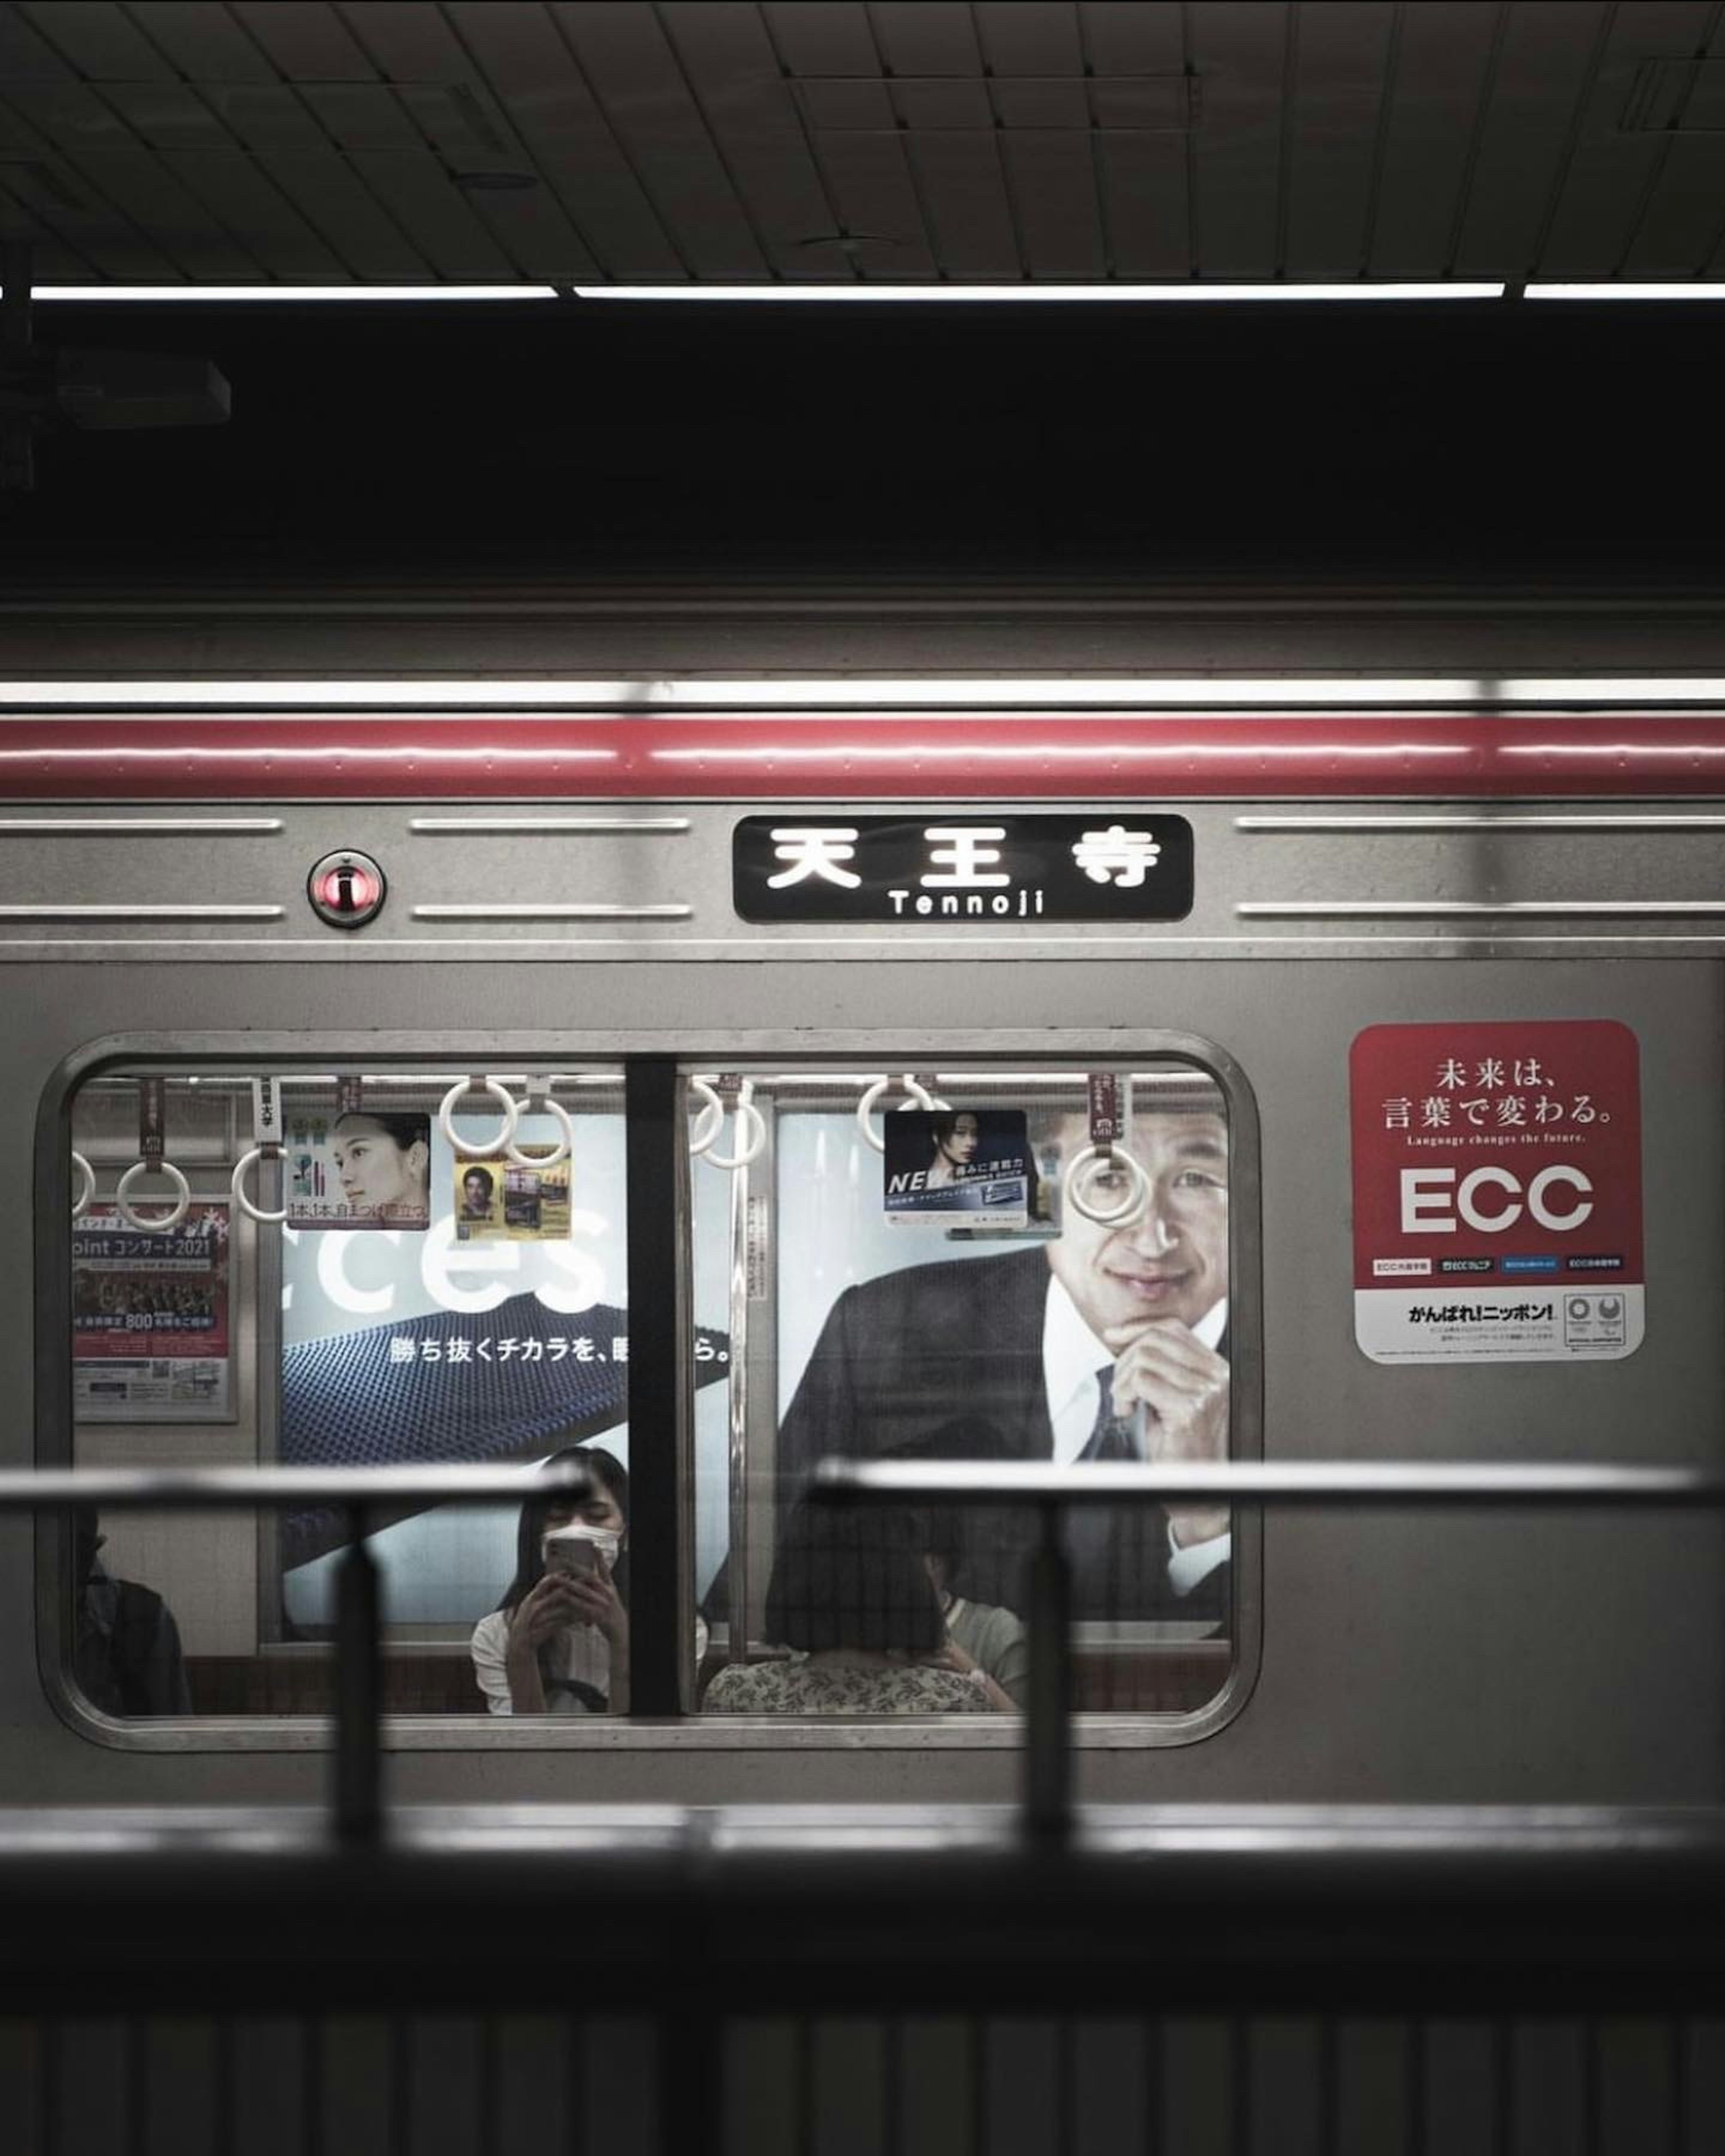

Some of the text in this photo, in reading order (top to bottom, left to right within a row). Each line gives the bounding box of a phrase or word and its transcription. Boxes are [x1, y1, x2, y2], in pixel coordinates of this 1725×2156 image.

[767, 826, 1160, 888] 天王寺
[888, 890, 1043, 916] Tennoji
[1437, 1058, 1554, 1090] 未来は、
[1382, 1095, 1611, 1128] 言葉で変わる。
[1407, 1133, 1586, 1147] Language changes the future.
[1400, 1165, 1593, 1233] ECC
[125, 1313, 153, 1329] 800
